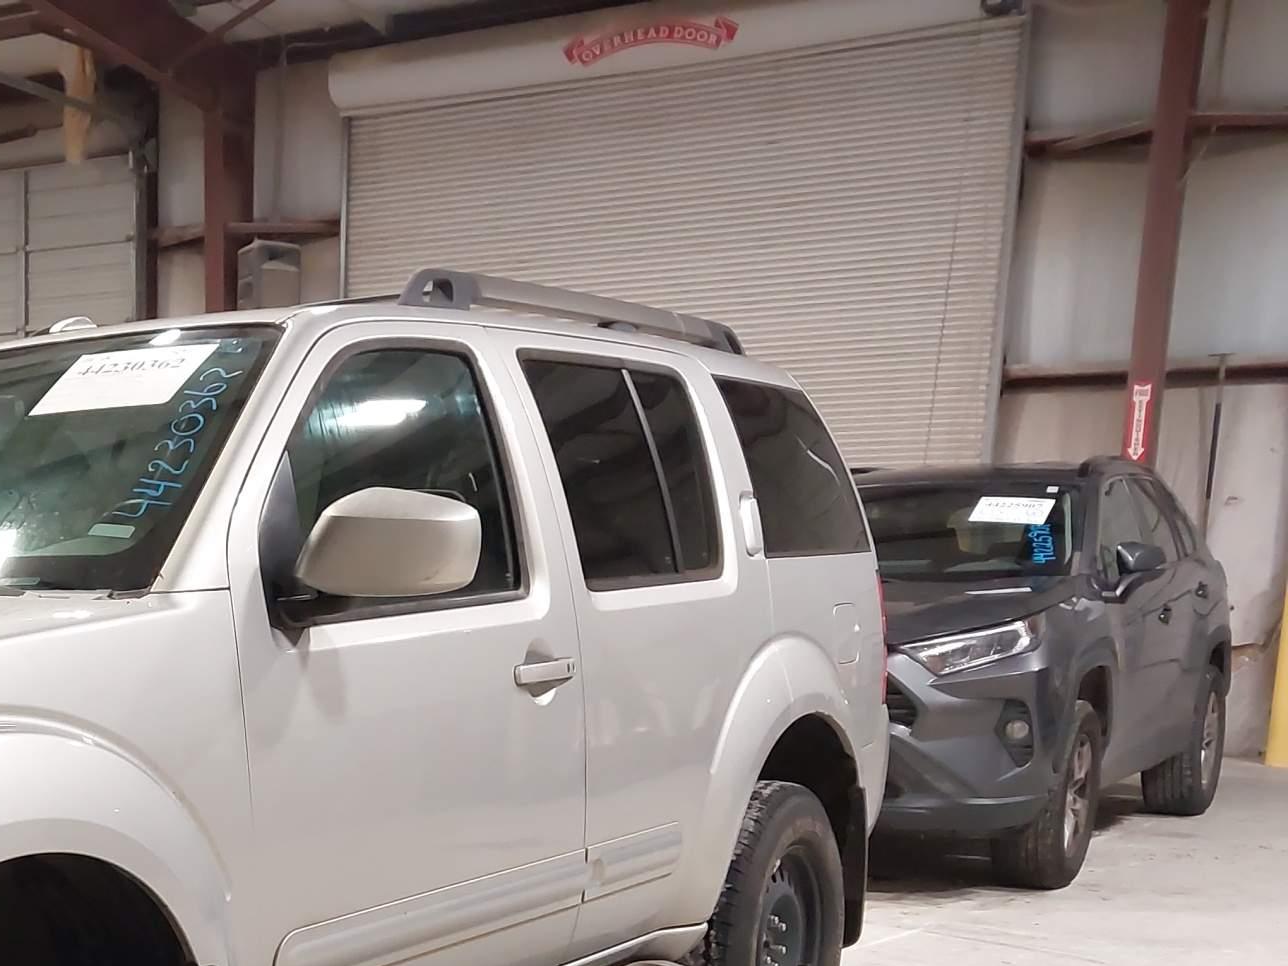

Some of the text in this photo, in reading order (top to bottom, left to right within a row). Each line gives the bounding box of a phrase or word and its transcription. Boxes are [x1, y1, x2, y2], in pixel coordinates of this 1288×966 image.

[582, 26, 718, 62] OVERHEAD DOOR
[77, 357, 187, 376] 44230362
[109, 367, 244, 518] 44230362
